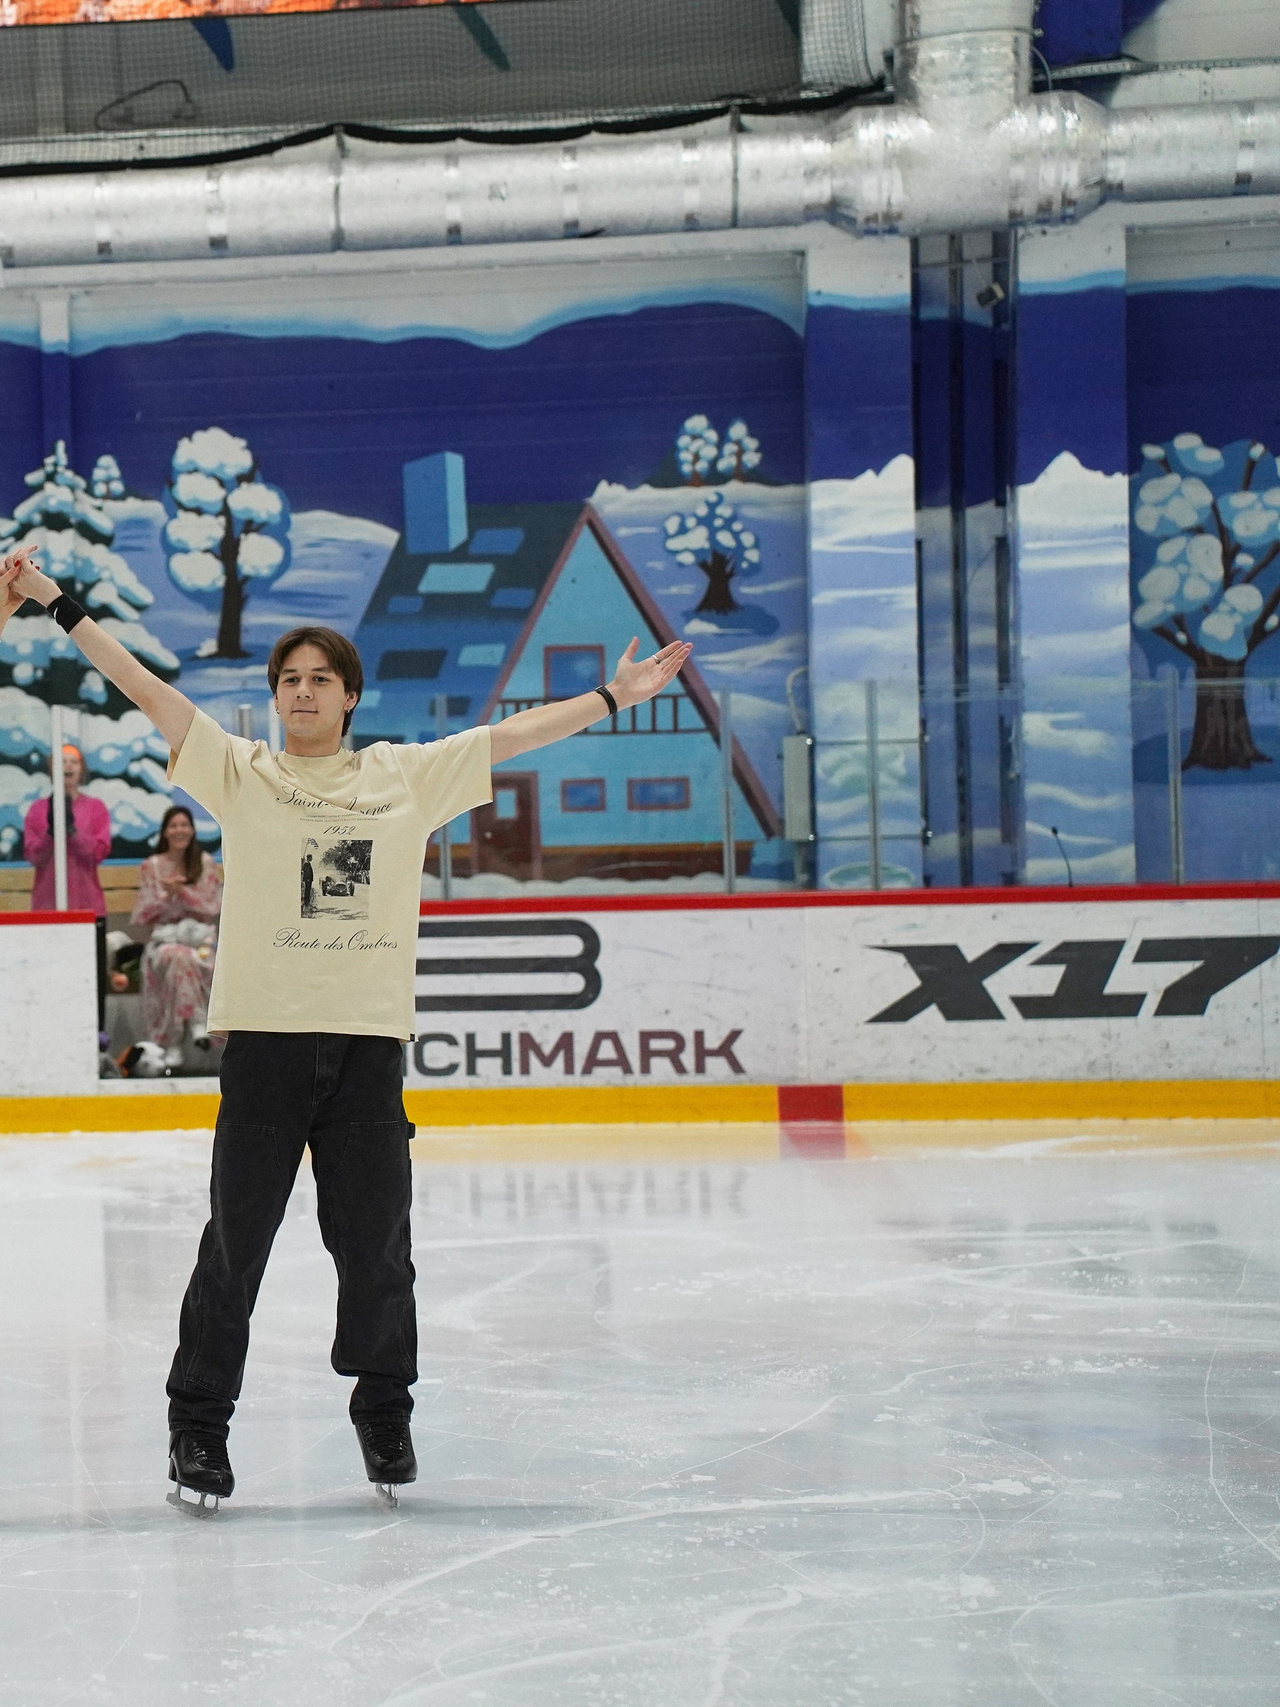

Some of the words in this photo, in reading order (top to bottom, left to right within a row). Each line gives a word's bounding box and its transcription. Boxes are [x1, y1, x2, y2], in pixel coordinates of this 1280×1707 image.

[323, 825, 357, 836] 1952
[273, 927, 320, 949] Route
[323, 936, 343, 950] des
[347, 929, 398, 950] Ombres
[864, 935, 1280, 1024] X17
[402, 1027, 747, 1078] CHMARK
